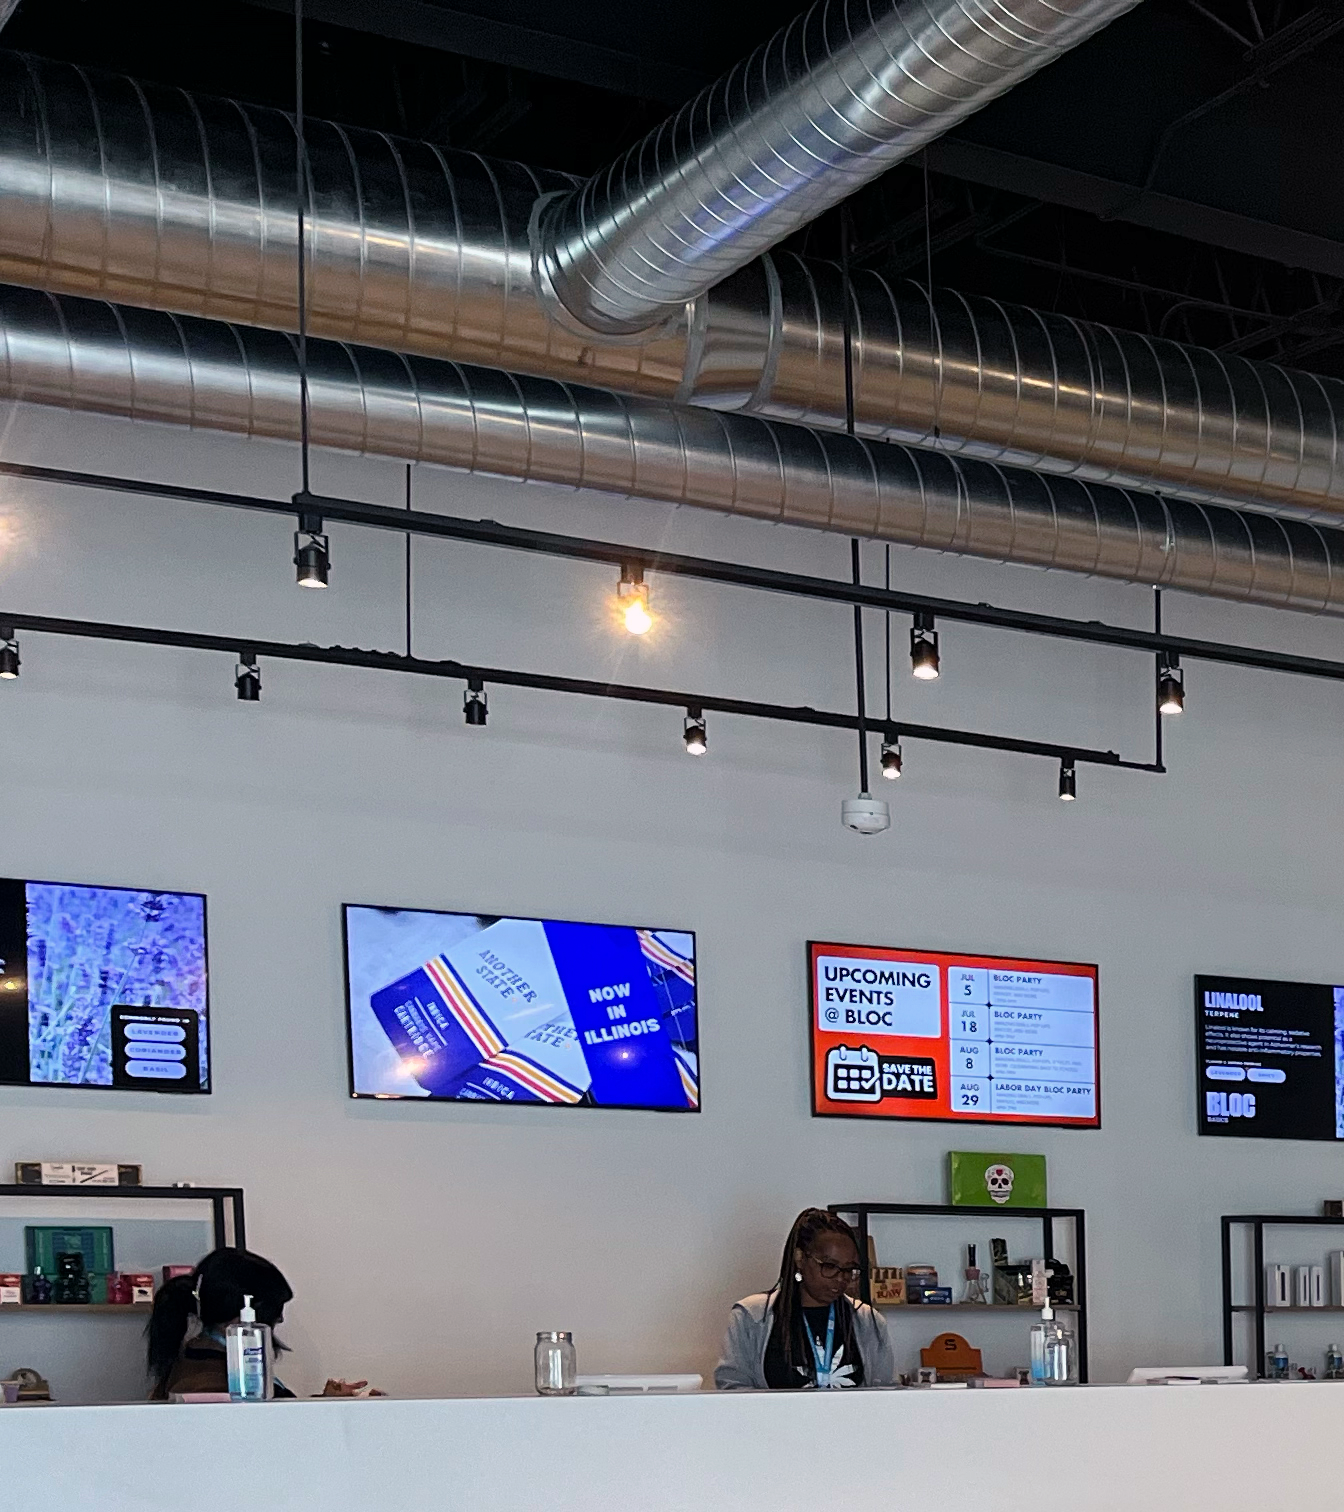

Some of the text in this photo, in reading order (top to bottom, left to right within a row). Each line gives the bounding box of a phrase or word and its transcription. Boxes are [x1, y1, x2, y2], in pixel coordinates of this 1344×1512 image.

[476, 965, 515, 1000] STATE
[478, 949, 537, 1004] ANOTHER
[824, 965, 931, 989] UPCOMING
[960, 972, 976, 982] JUL
[993, 974, 1043, 985] BLOC PARTY
[588, 982, 631, 1004] NOW
[825, 986, 894, 1006] EVENTS
[963, 985, 972, 996] 5
[1203, 990, 1264, 1012] LINALOOL
[606, 1003, 627, 1021] IN
[825, 1007, 894, 1027] @ BLOC
[960, 1009, 976, 1019] JUL
[994, 1010, 1044, 1021] BLOC PARTY
[1204, 1009, 1240, 1019] TERPENE
[583, 1017, 661, 1046] ILLINOIS
[961, 1021, 978, 1033] 18
[959, 1046, 979, 1055] AUG
[994, 1046, 1044, 1057] BLOC PARTY
[882, 1062, 933, 1076] SAVE THE
[965, 1057, 974, 1070] 8
[882, 1074, 935, 1094] DATE
[960, 1083, 980, 1092] AUG
[995, 1083, 1093, 1096] LABOR DAY BLOC PARTY
[961, 1094, 979, 1107] 29
[1206, 1091, 1256, 1118] BLOC
[876, 1288, 902, 1300] RAW
